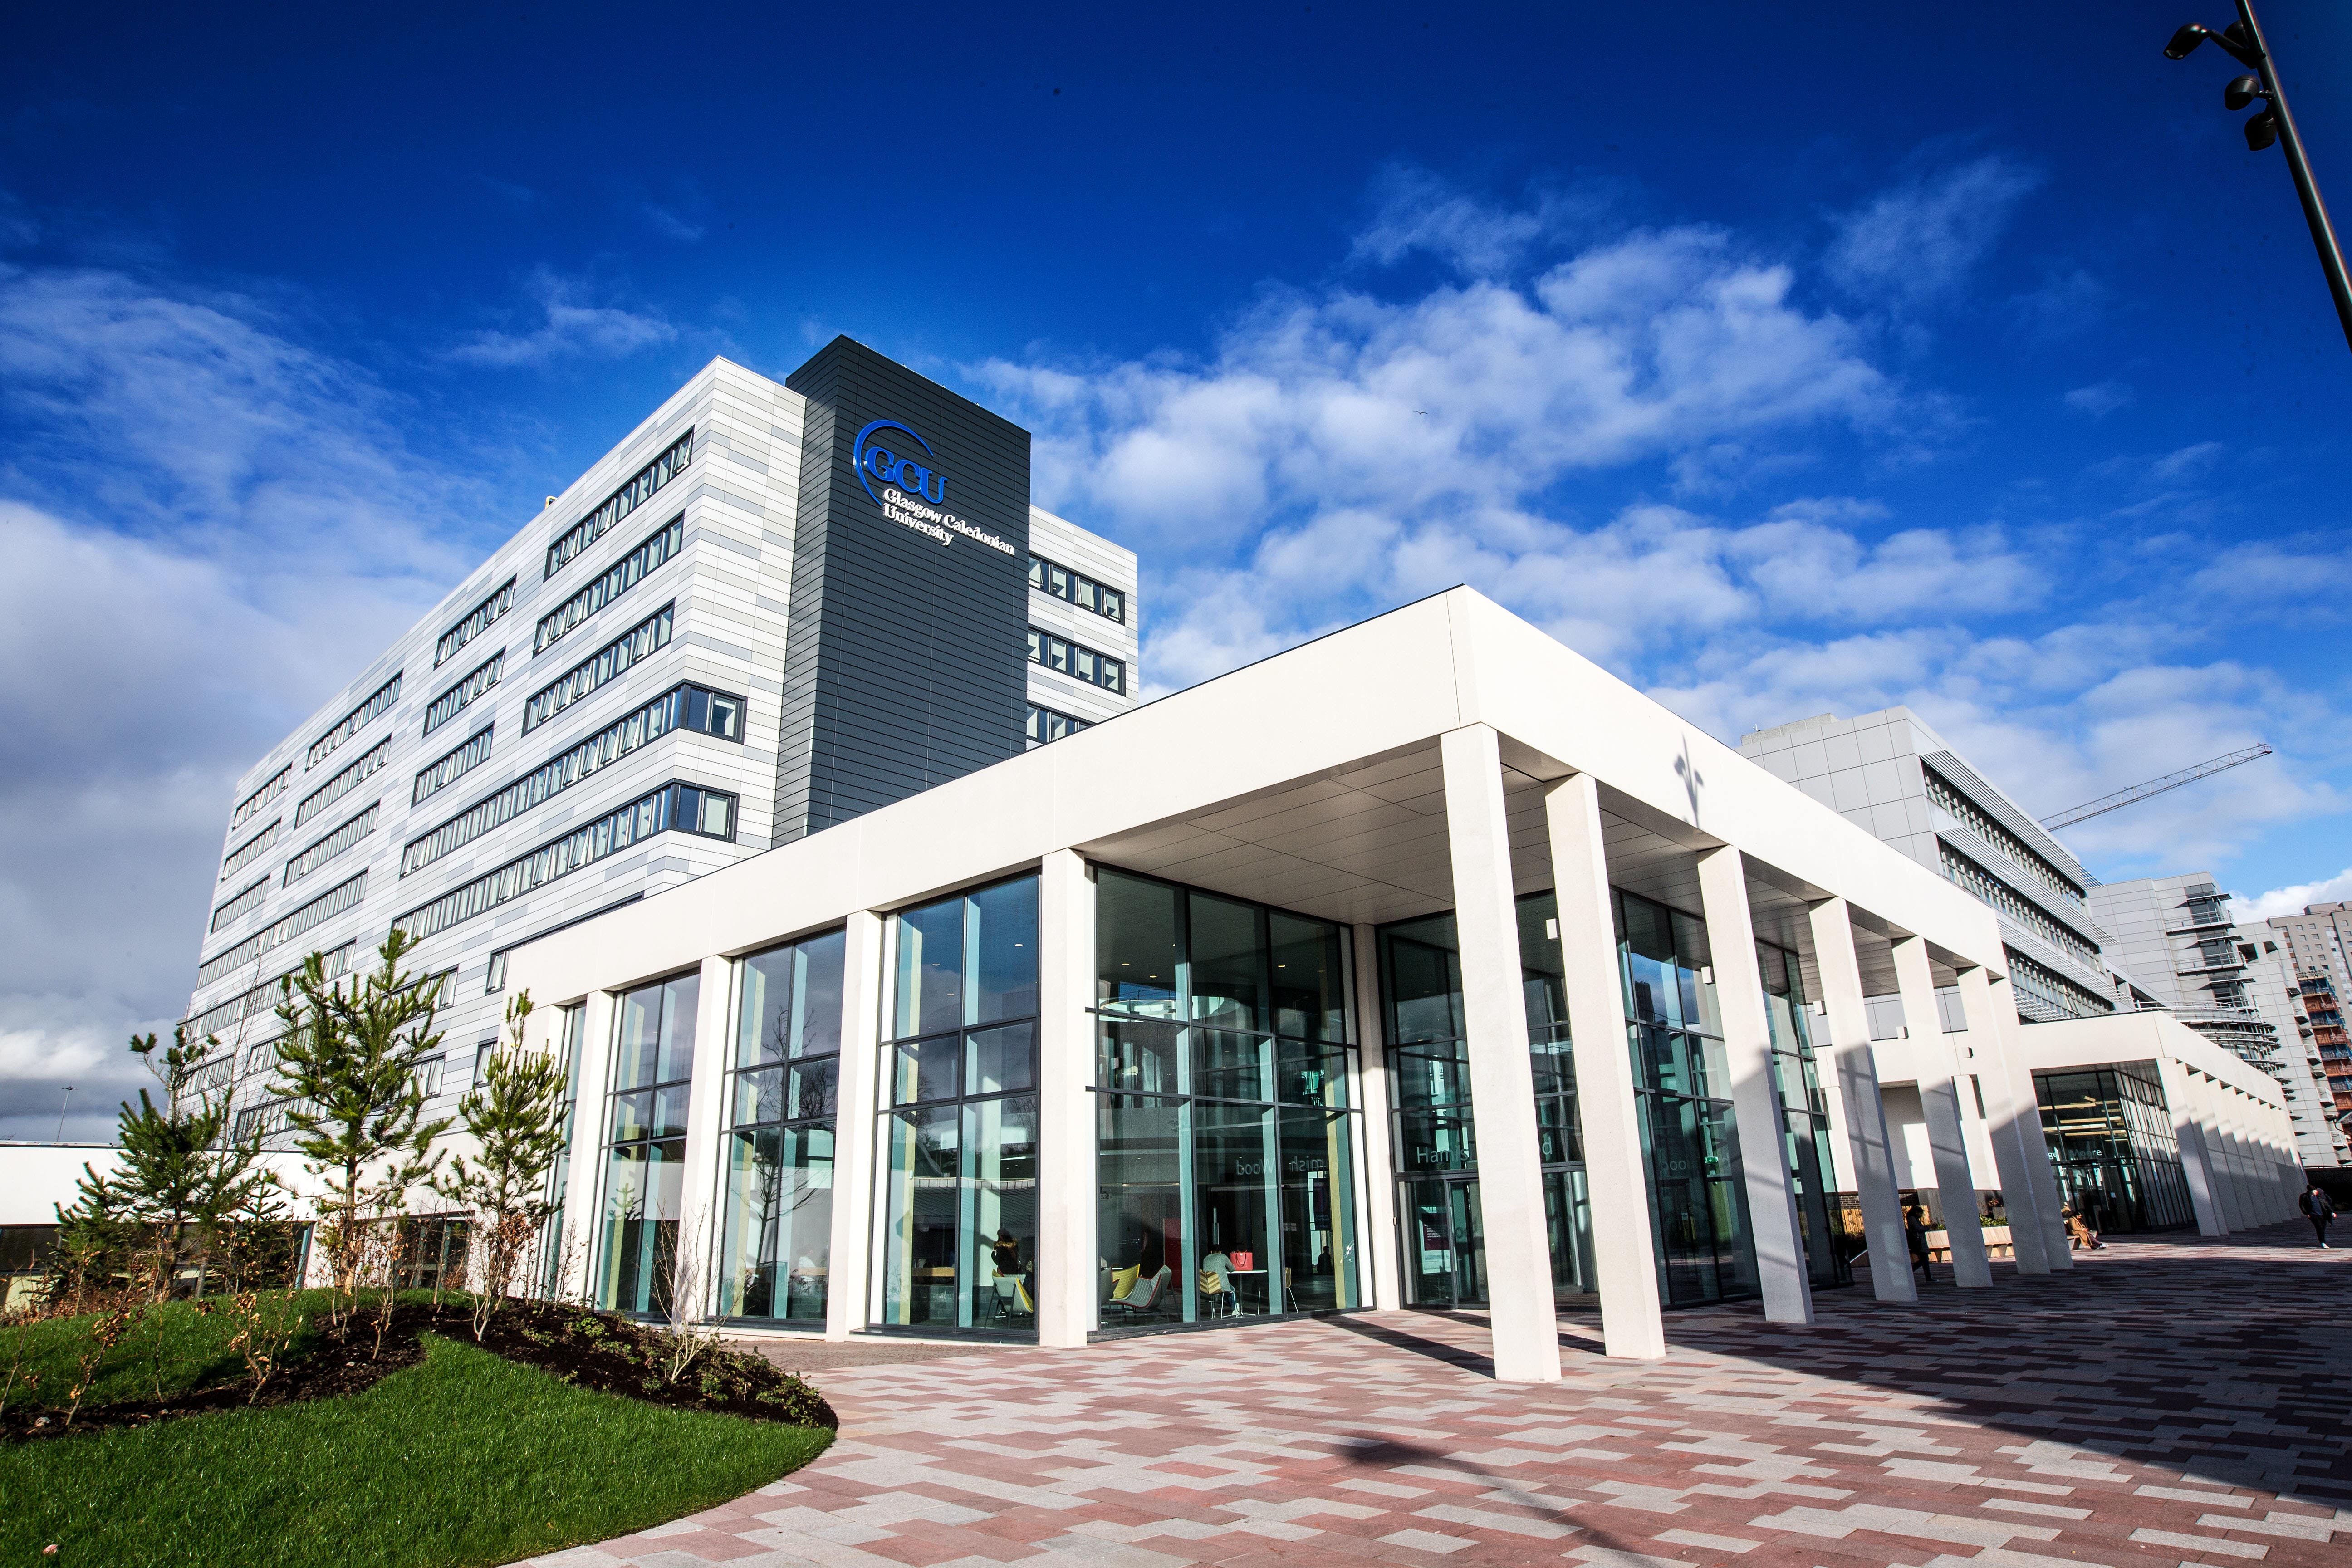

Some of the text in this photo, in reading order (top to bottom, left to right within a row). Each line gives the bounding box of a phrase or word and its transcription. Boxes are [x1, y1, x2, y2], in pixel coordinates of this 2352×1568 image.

[864, 446, 948, 504] GCU
[883, 488, 1015, 556] Glasgow Caledonian
[883, 503, 954, 545] University
[1416, 1146, 1470, 1164] Hamis
